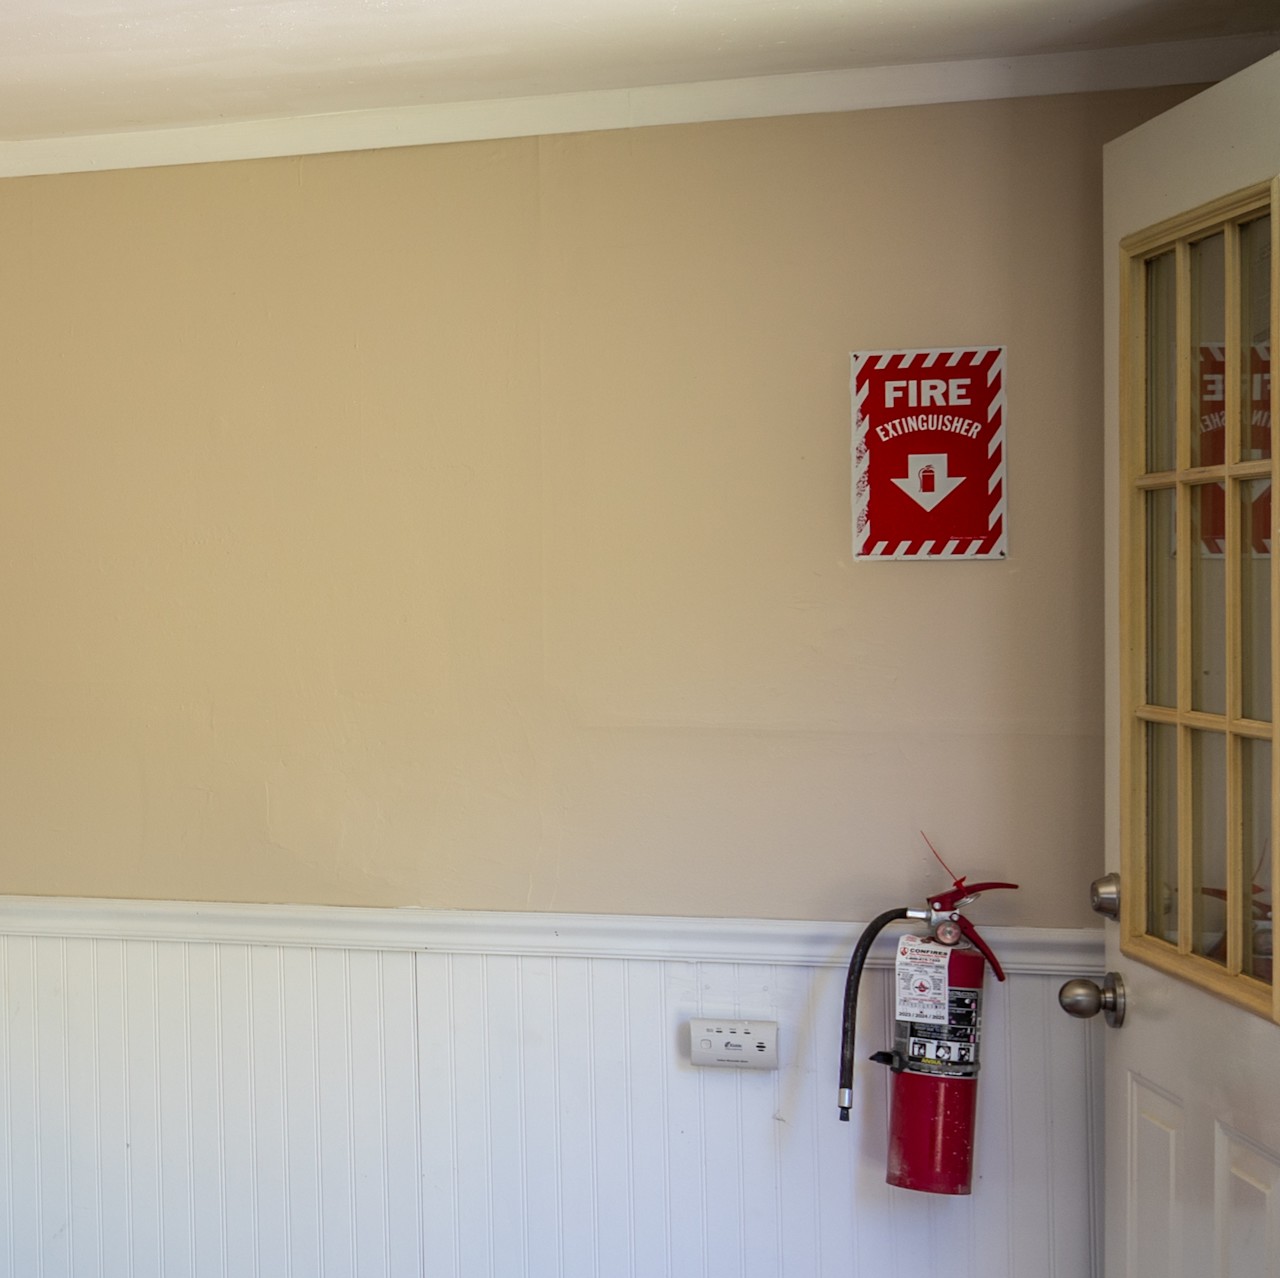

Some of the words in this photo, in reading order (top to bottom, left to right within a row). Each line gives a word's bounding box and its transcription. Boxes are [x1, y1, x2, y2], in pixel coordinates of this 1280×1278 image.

[885, 378, 971, 408] FIRE
[875, 414, 982, 442] EXTINGUISHER
[910, 948, 948, 956] CONFIRES
